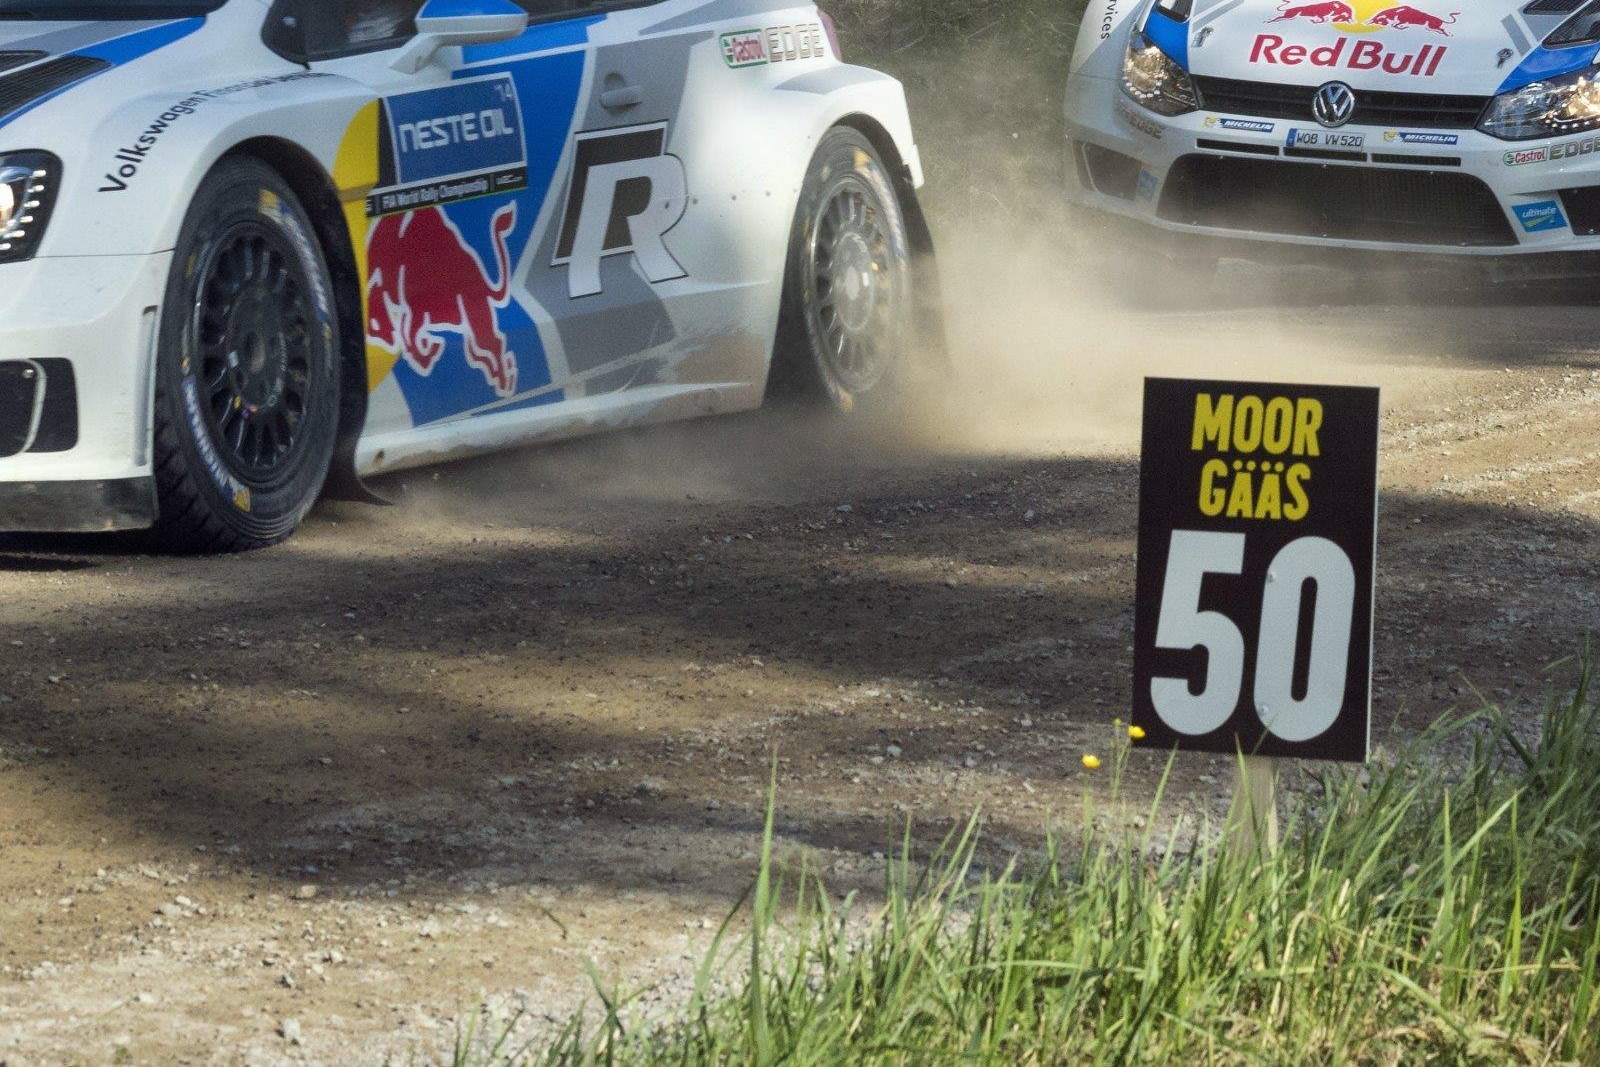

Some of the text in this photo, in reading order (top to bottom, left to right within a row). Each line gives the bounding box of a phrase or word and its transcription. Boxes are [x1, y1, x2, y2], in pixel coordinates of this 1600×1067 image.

[766, 23, 824, 63] EDGE
[1249, 34, 1448, 76] Red Bull
[98, 90, 208, 193] Volkswagen
[398, 112, 480, 153] NESTE
[1223, 120, 1273, 131] MICHELIN
[1296, 133, 1319, 145] WOB
[1404, 134, 1457, 144] MICHELIN
[1514, 149, 1546, 164] Castrol
[564, 146, 690, 301] R
[1191, 393, 1323, 457] MOOR
[1199, 458, 1311, 521] GÄÄS
[1150, 529, 1356, 742] 50
